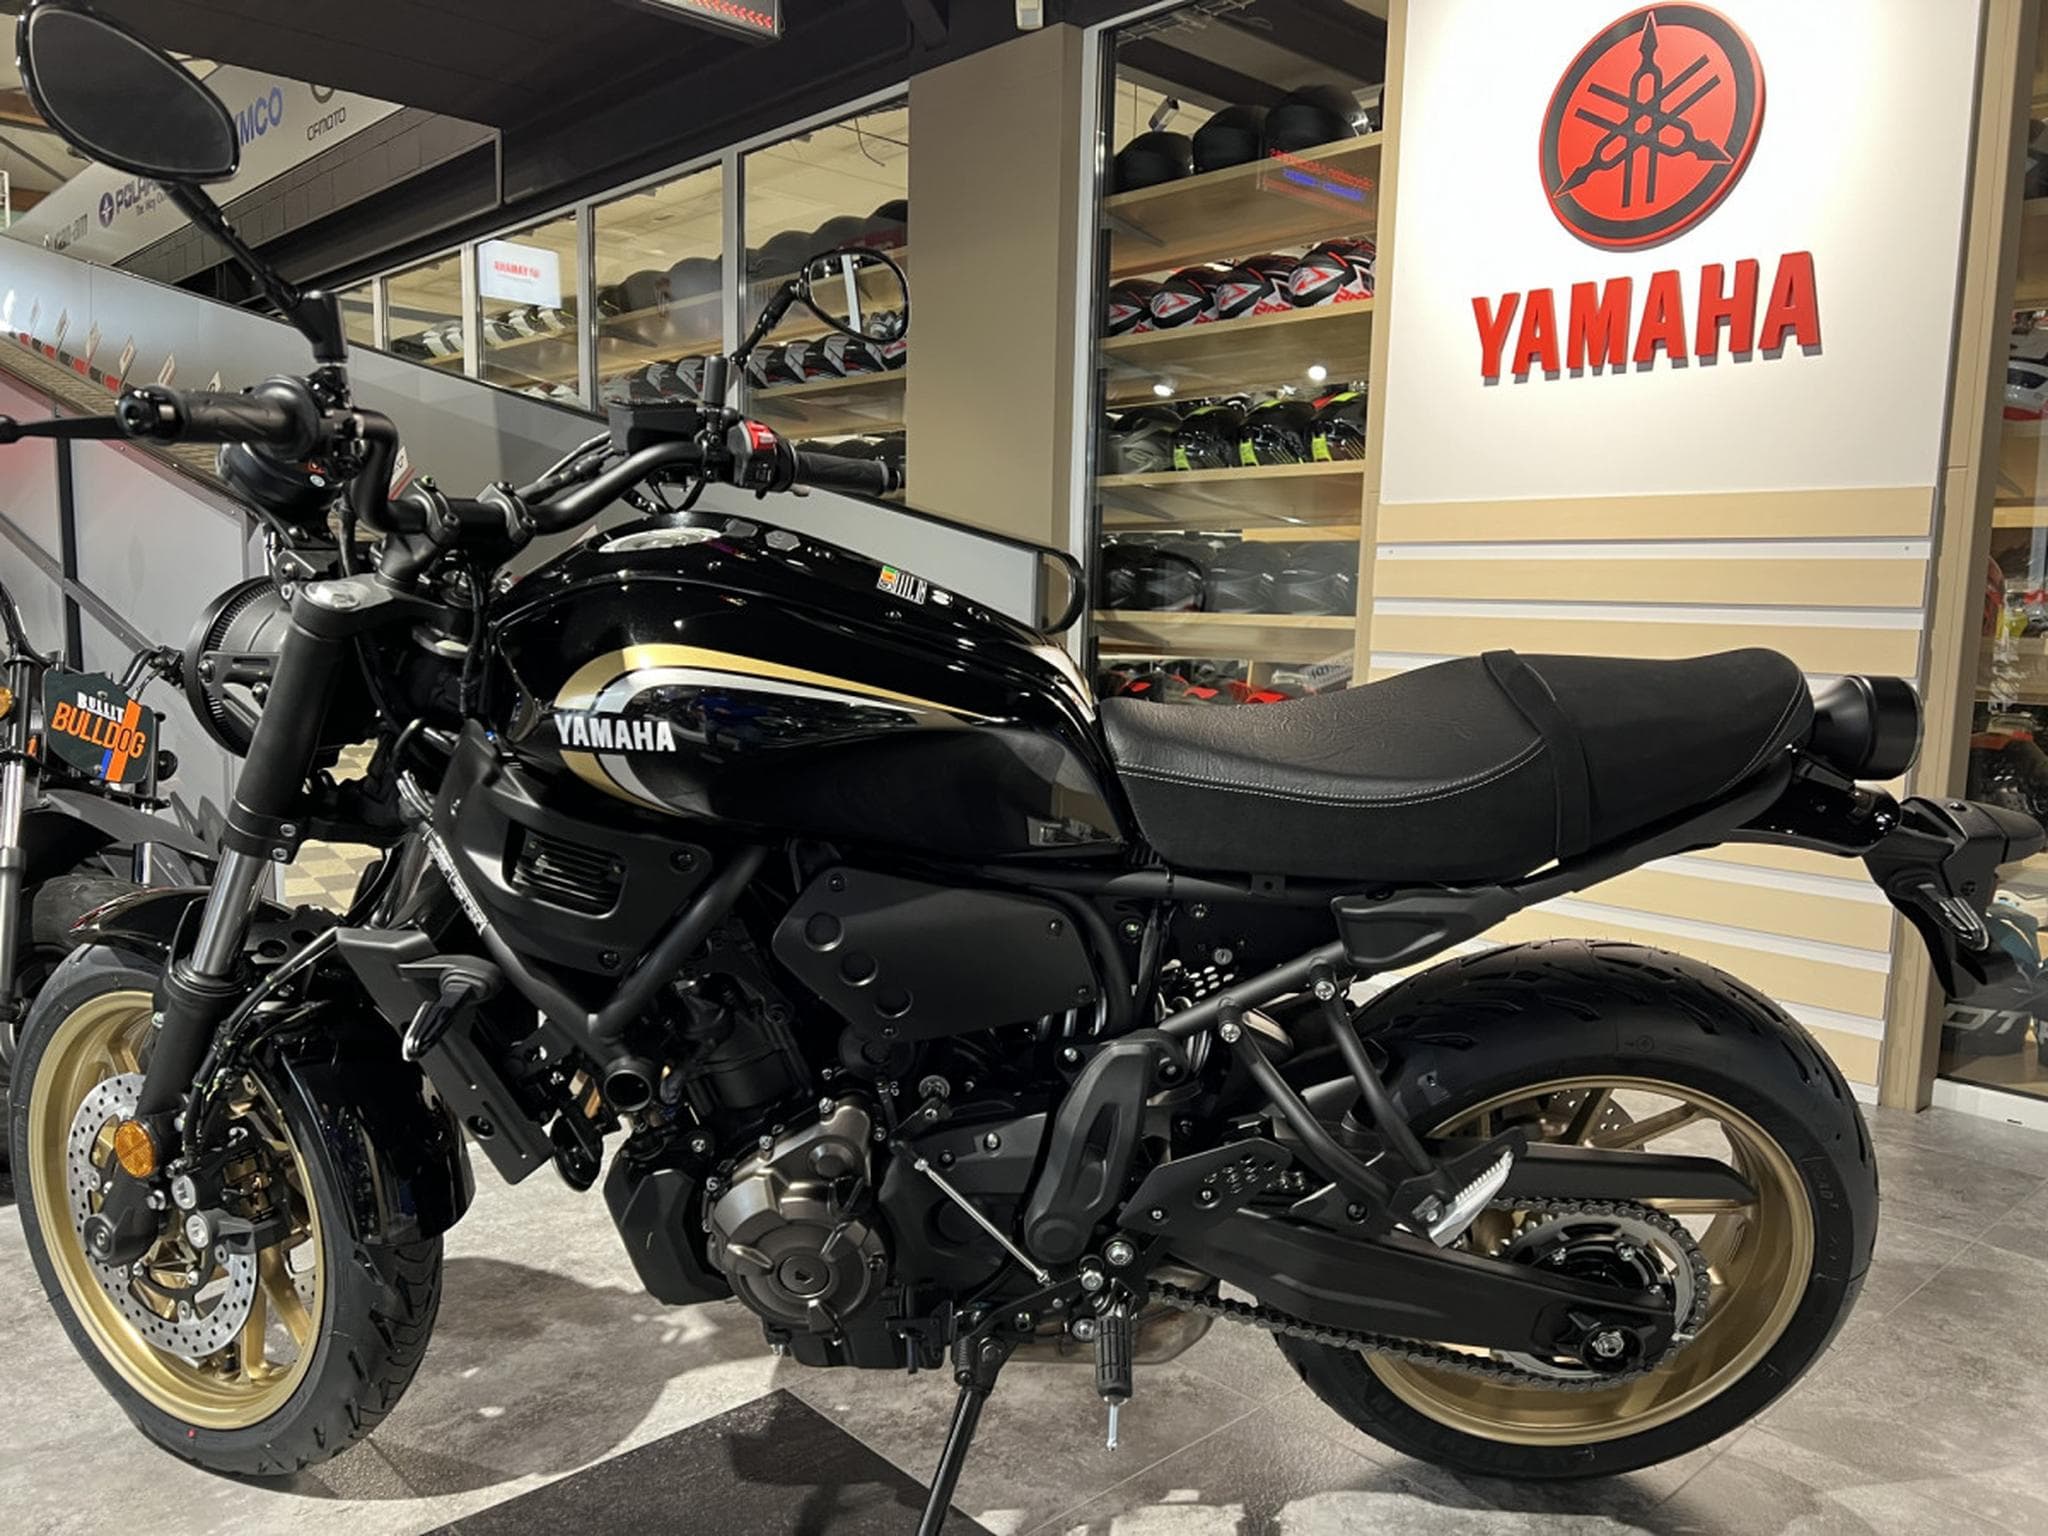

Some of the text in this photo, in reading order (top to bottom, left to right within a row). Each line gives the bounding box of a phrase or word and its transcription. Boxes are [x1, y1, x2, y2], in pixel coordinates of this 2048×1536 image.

[235, 86, 283, 147] MCO
[1471, 250, 1820, 380] YAMAHA
[51, 701, 146, 758] BULLDOG
[77, 690, 125, 723] BULLIT
[553, 713, 676, 752] YAMAHA
